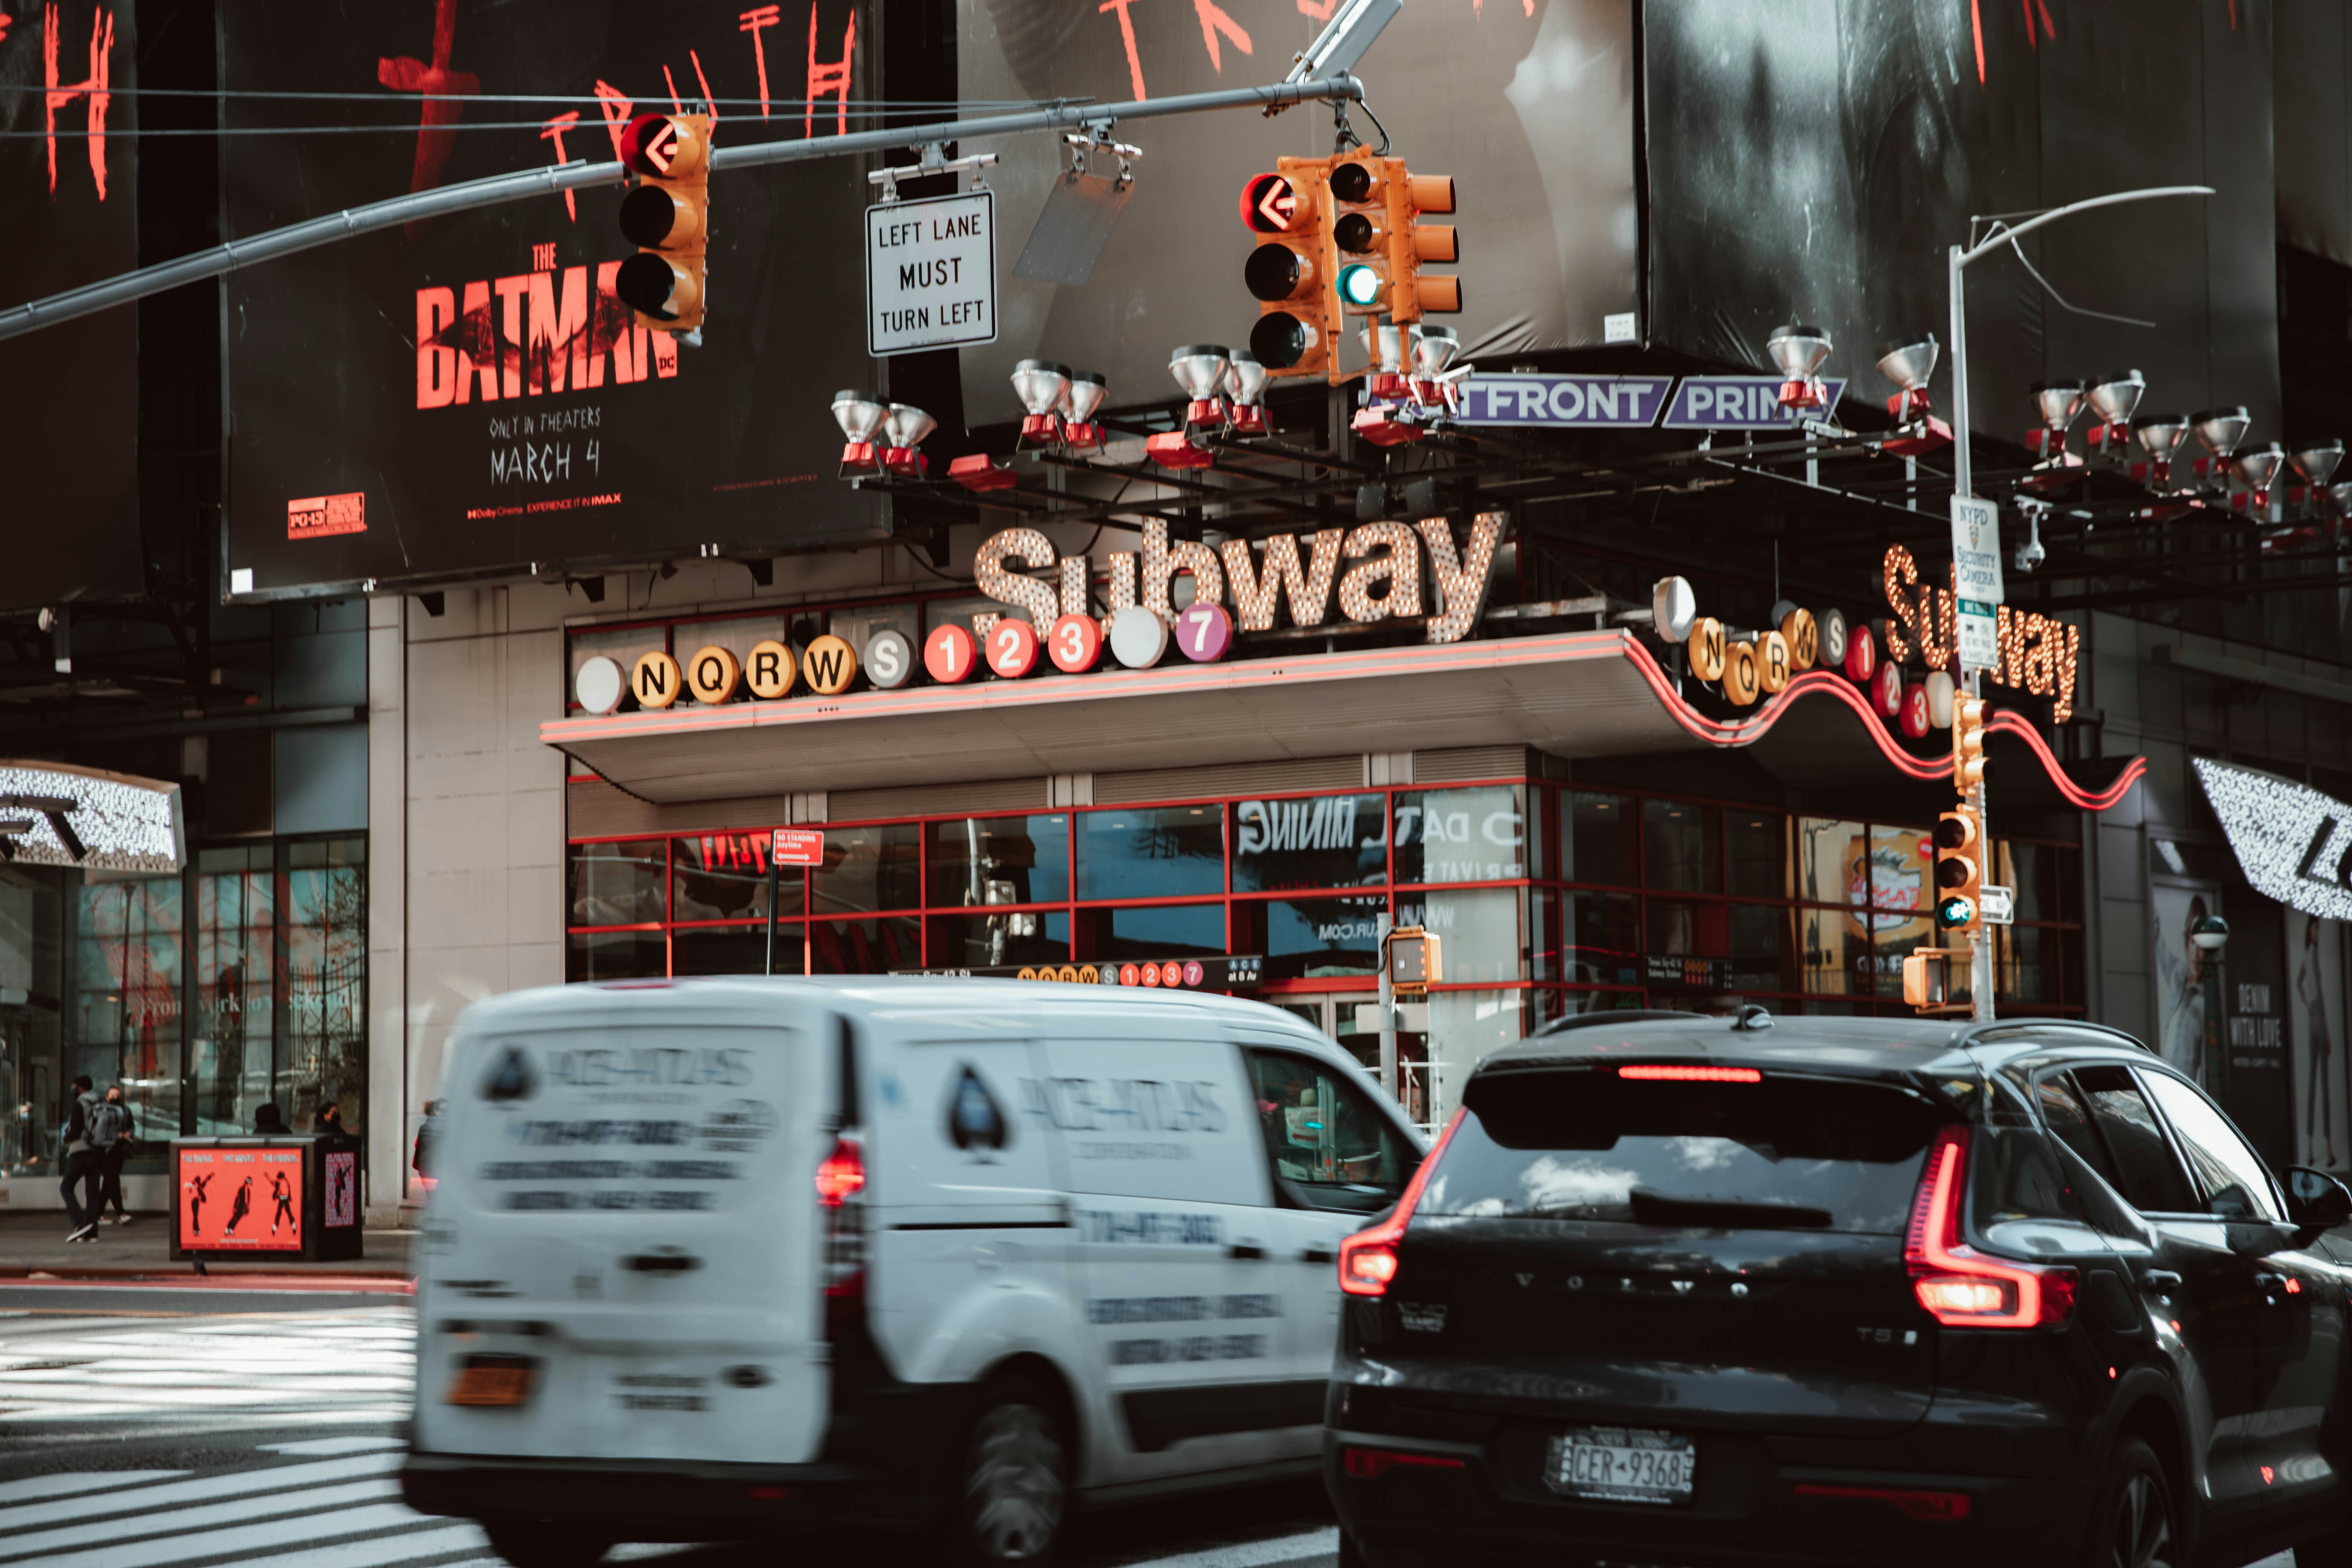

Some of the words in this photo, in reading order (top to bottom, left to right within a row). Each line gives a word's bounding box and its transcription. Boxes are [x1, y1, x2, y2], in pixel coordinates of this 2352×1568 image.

[879, 221, 921, 248] LEFT
[934, 214, 981, 241] LANE
[532, 243, 557, 271] THE
[900, 256, 962, 291] MUST
[881, 307, 929, 333] TURN
[940, 299, 983, 326] LEFT
[658, 355, 675, 371] DC
[1379, 380, 1654, 420] TFRONT
[490, 416, 518, 439] ONLY
[524, 416, 534, 435] IN
[541, 404, 600, 433] THEATERS
[491, 441, 570, 485] MARCH
[587, 437, 599, 478] 4
[476, 507, 496, 519] Dolby
[497, 505, 523, 516] Cinema
[527, 498, 572, 514] EXPERIENCE
[574, 498, 580, 507] IT
[582, 497, 590, 507] IN
[591, 492, 621, 506] IMAX
[1960, 505, 1988, 526] NYPD
[974, 511, 1505, 643] Subway
[1884, 543, 2079, 723] Suway
[642, 662, 665, 696] N
[697, 657, 723, 691] Q
[755, 652, 779, 686] R
[808, 649, 844, 687] W
[874, 639, 899, 678] S
[940, 634, 955, 672] 1
[998, 628, 1021, 669] 2
[1060, 622, 1084, 663] 3
[1189, 610, 1213, 652] 7
[1706, 630, 1720, 669] N
[1740, 655, 1755, 693] Q
[1772, 643, 1785, 681] R
[1796, 622, 1813, 661] W
[1829, 621, 1843, 657] S
[1860, 633, 1870, 672] 1
[1886, 674, 1900, 709] 2
[1914, 691, 1926, 731] 3
[777, 841, 802, 850] Anytime
[787, 833, 816, 843] STANDING
[1082, 971, 1094, 983] W
[1104, 969, 1114, 984] S
[1126, 968, 1132, 983] 1
[1147, 968, 1155, 983] 2
[1167, 967, 1176, 982] 3
[1188, 966, 1198, 982] 7
[1228, 971, 1236, 982] at
[1247, 971, 1257, 982] Av
[1230, 960, 1236, 969] A
[1253, 960, 1259, 968] E
[1514, 1272, 1749, 1298] VOLVO
[1574, 1447, 1613, 1483] CER
[1629, 1450, 1681, 1487] 9368
